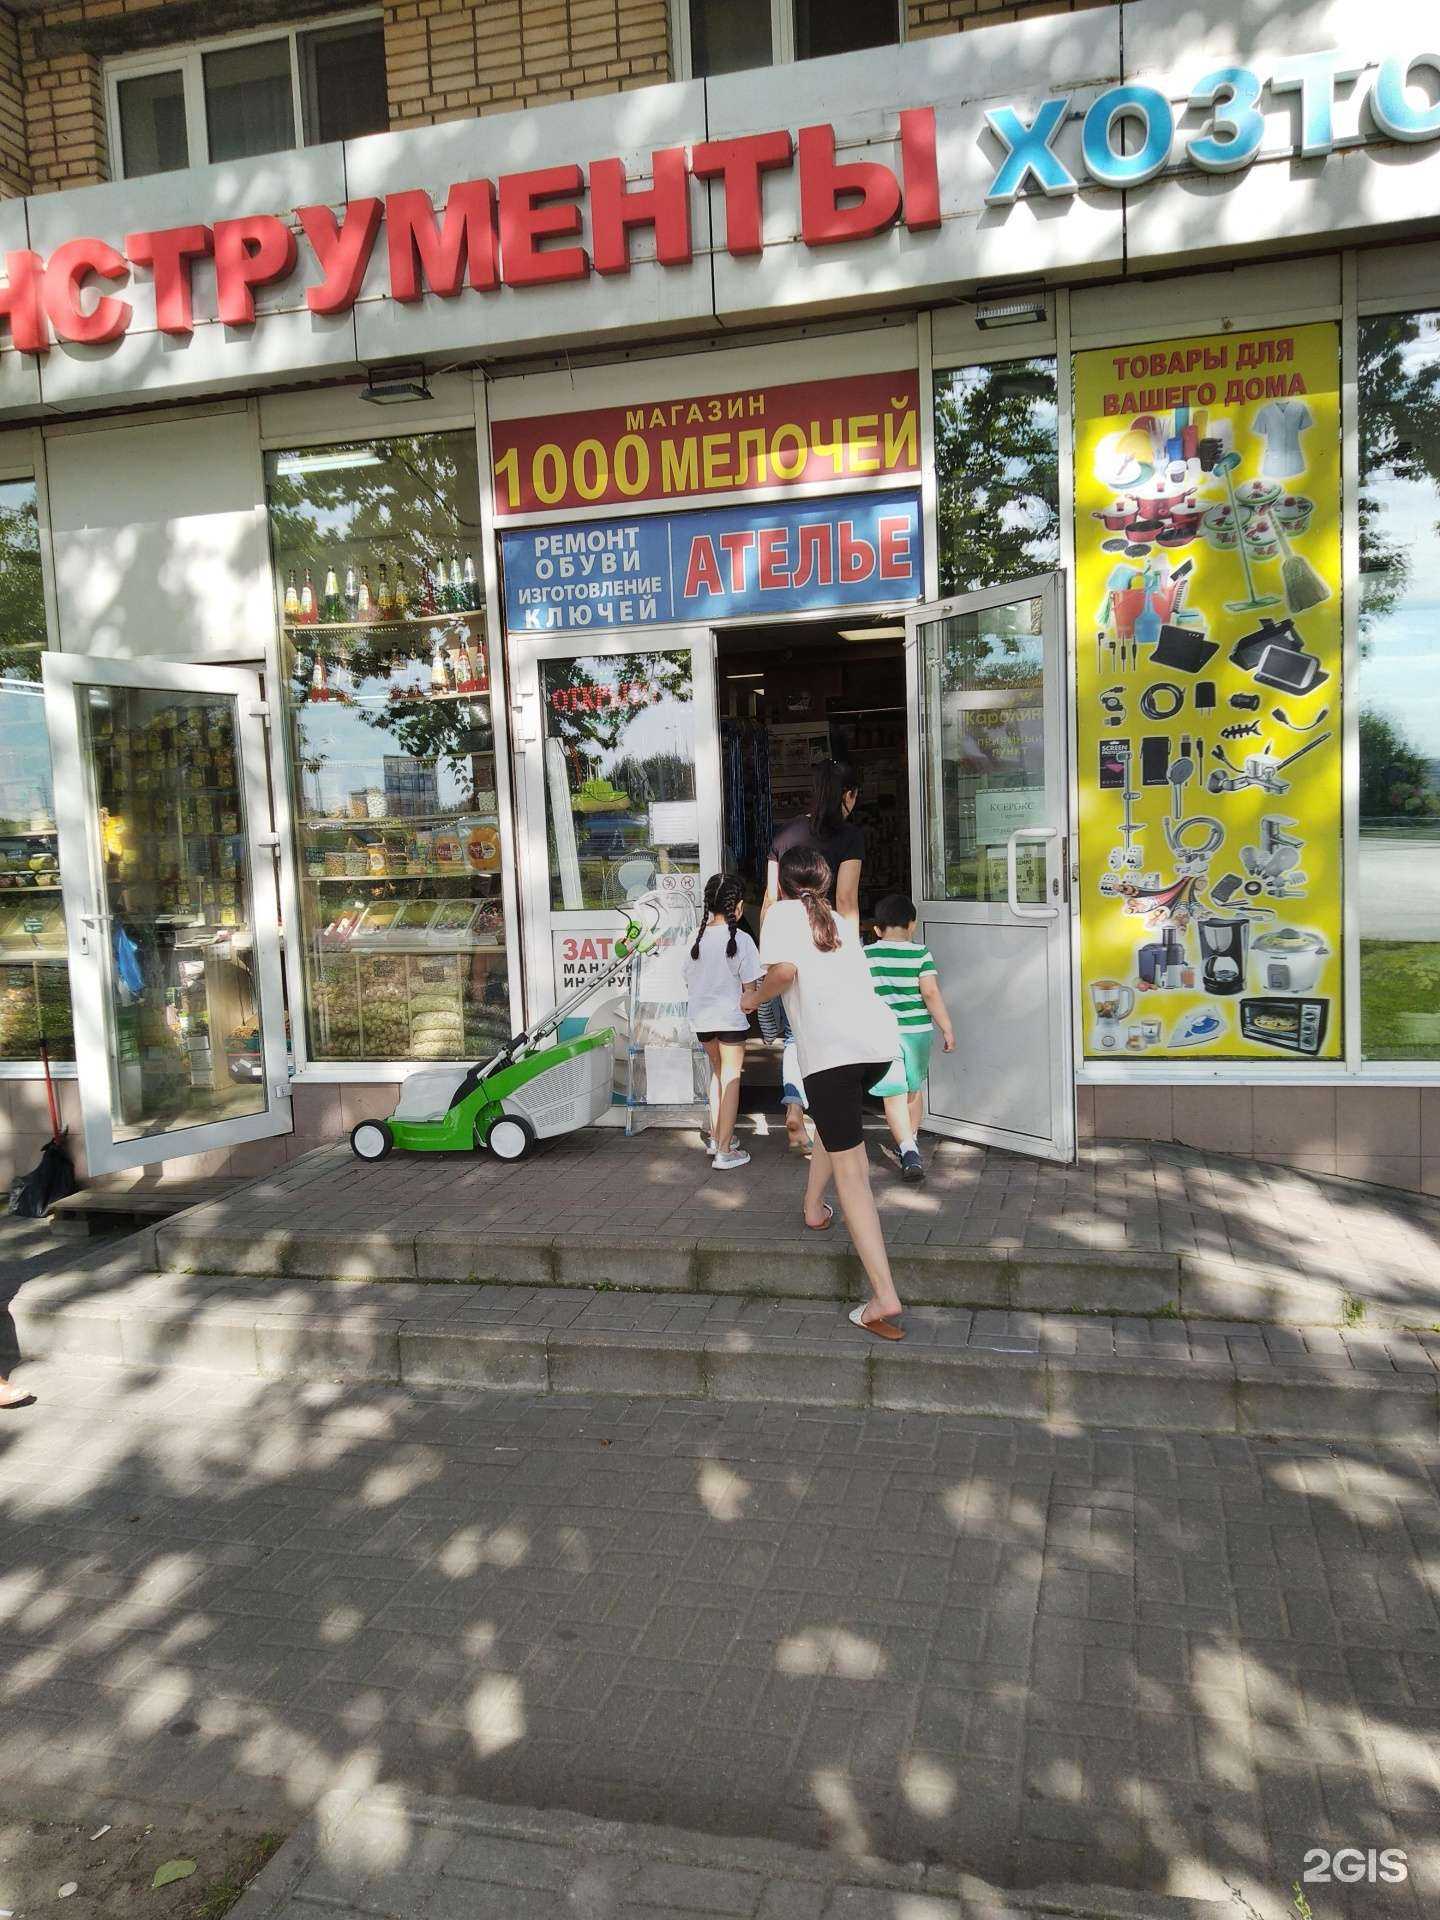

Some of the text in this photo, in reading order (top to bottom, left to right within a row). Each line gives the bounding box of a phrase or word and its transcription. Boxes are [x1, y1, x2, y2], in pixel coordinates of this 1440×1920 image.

[1112, 337, 1295, 380] ТОВАРЫ ДЛЯ
[625, 394, 767, 432] МАГАЗИН
[1102, 372, 1307, 417] ВАШЕГО ДОМА
[495, 395, 918, 508] 1000 МЕЛОЧЕЙ
[534, 526, 640, 557] РЕМОНТ
[683, 514, 914, 598] АТЕЛЬЕ
[535, 550, 641, 580] ОБУВИ
[518, 576, 662, 605] ИЗГОТОВЛЕНИЕ
[525, 594, 657, 630] КЛЮЧЕЙ
